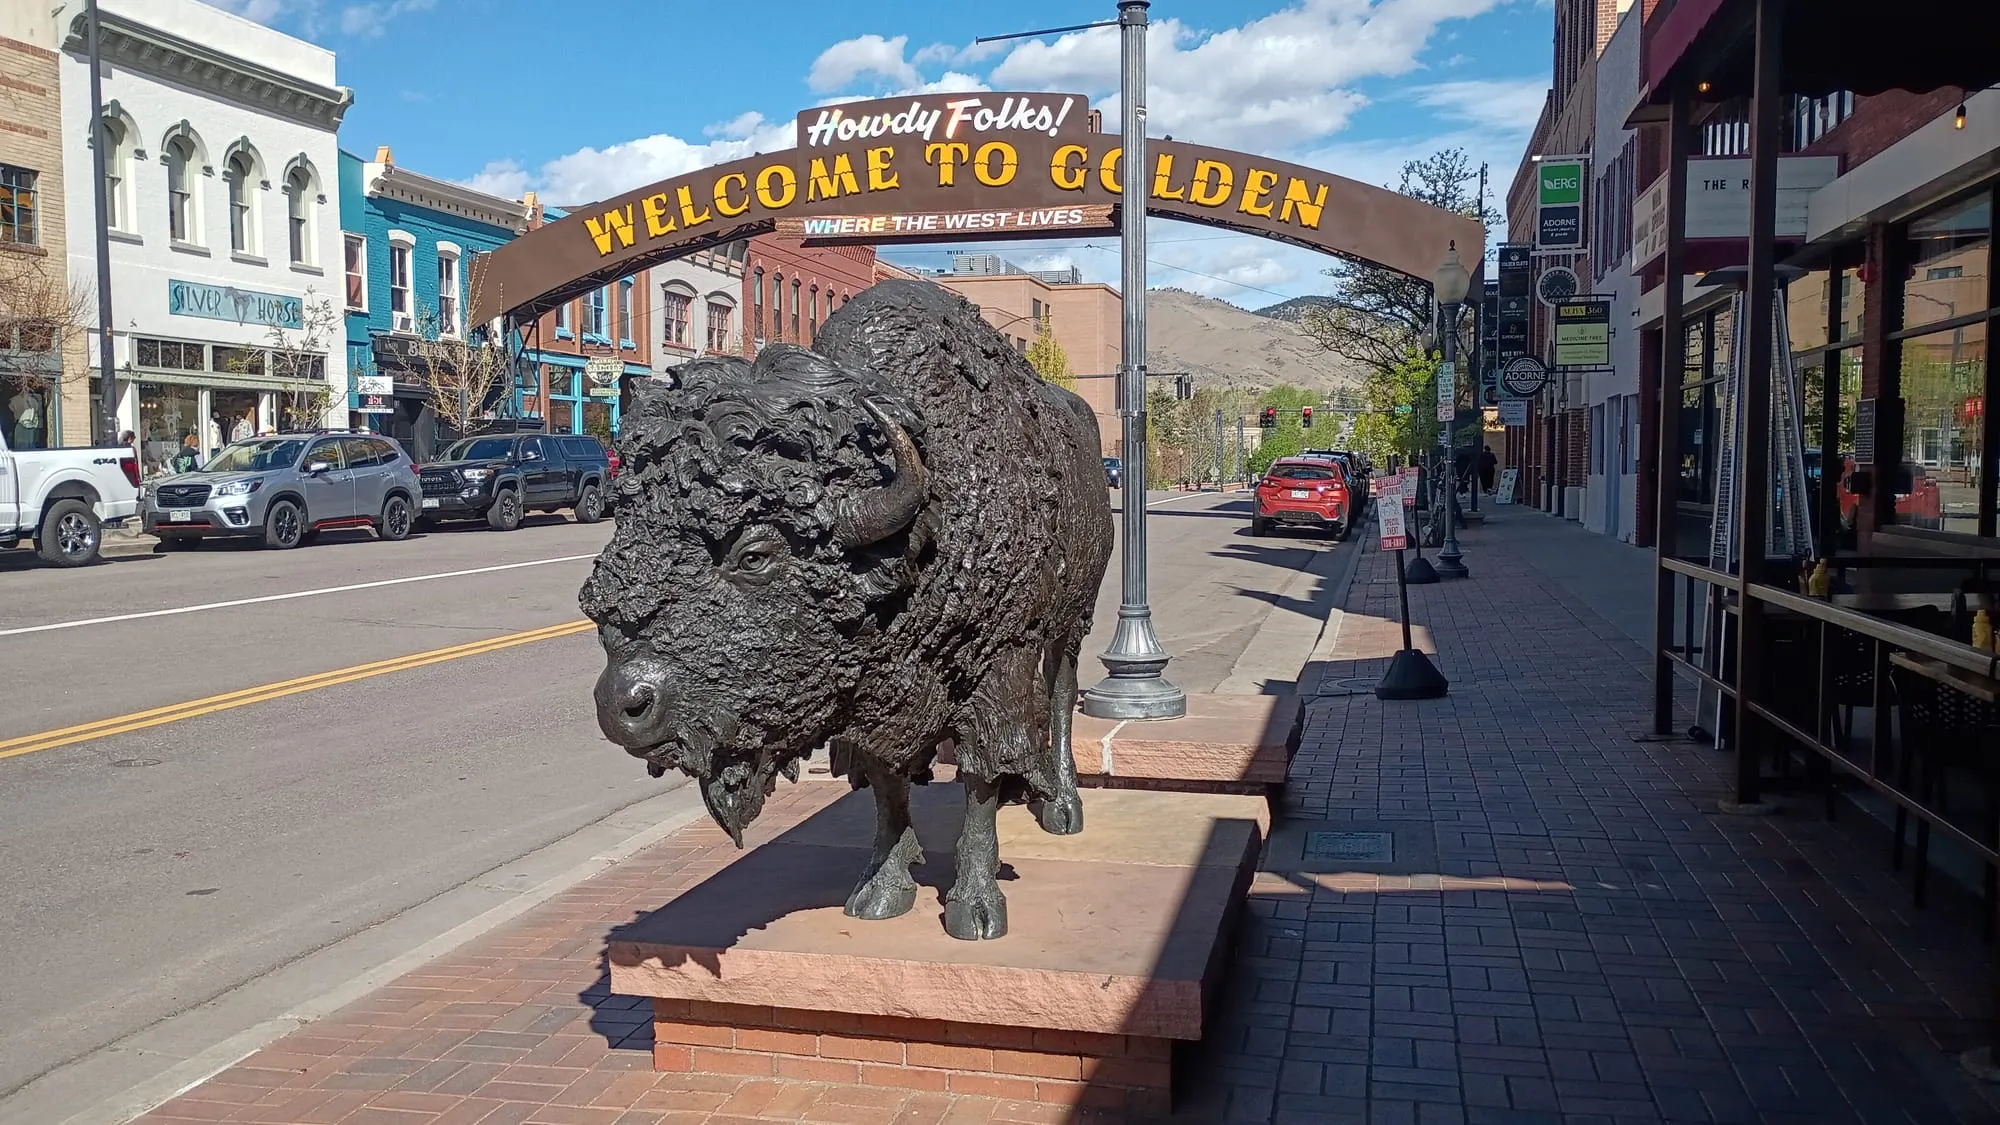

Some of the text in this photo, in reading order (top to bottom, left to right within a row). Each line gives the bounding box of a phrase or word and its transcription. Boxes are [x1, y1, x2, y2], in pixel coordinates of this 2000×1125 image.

[807, 97, 1074, 147] Howdy Folks!
[1553, 177, 1577, 190] ERG
[1703, 179, 1727, 190] THE
[583, 145, 899, 256] WELCOME
[925, 140, 1019, 188] TO
[803, 208, 1084, 235] WHERE THE WEST LIVES
[1543, 218, 1577, 227] ADORNE
[258, 297, 300, 323] HORSE
[1505, 371, 1546, 380] ADORNE
[1383, 486, 1401, 496] PARKING
[1386, 527, 1399, 535] EVENT
